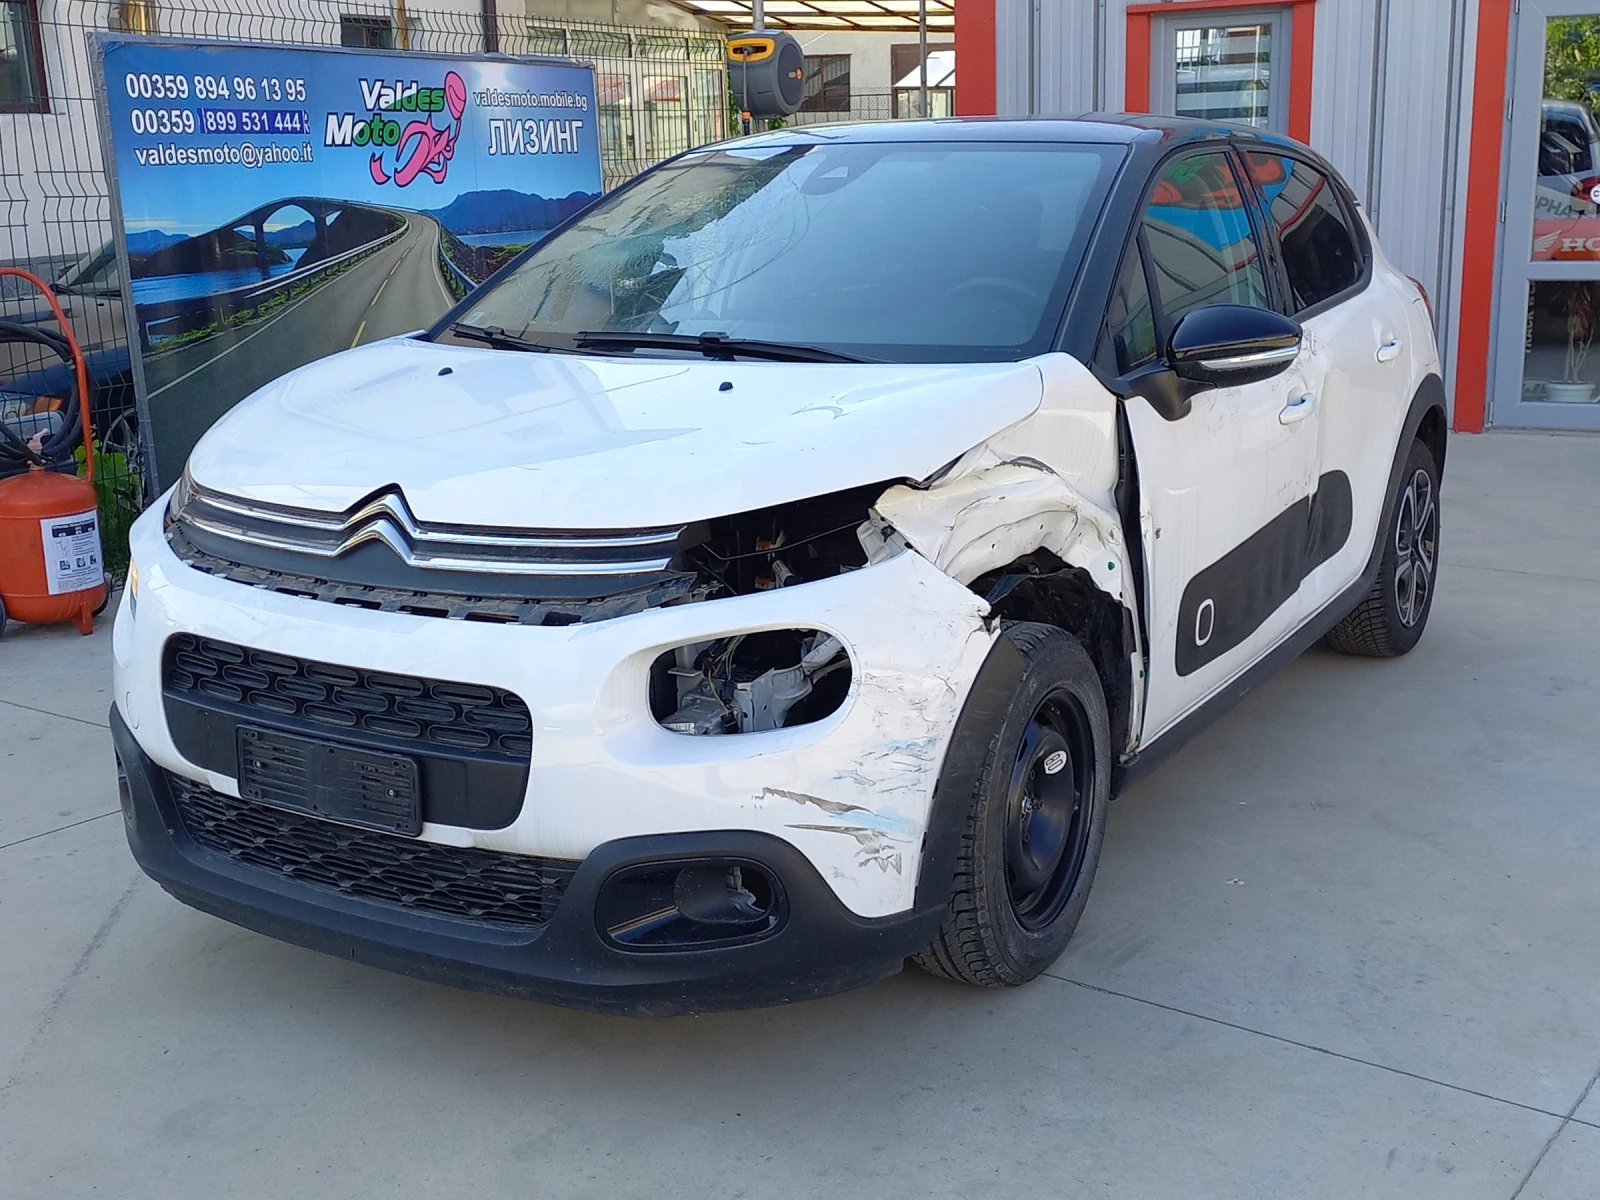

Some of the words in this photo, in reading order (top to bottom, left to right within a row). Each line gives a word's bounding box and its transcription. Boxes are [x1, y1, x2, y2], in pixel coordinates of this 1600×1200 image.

[125, 73, 188, 99] 00359
[195, 75, 230, 100] 894
[233, 76, 256, 101] 96
[261, 77, 282, 102] 13
[285, 78, 306, 102] 95
[359, 78, 446, 111] Valdes
[473, 88, 588, 112] valdesmoto.mobile.bg
[131, 108, 195, 135] 00359
[207, 111, 237, 131] 899
[242, 112, 269, 131] 531
[275, 112, 301, 131] 444
[324, 112, 400, 147] Moto
[488, 118, 584, 156] ЛИЗИНГ
[135, 142, 313, 168] valdesmoto@yahoo.it
